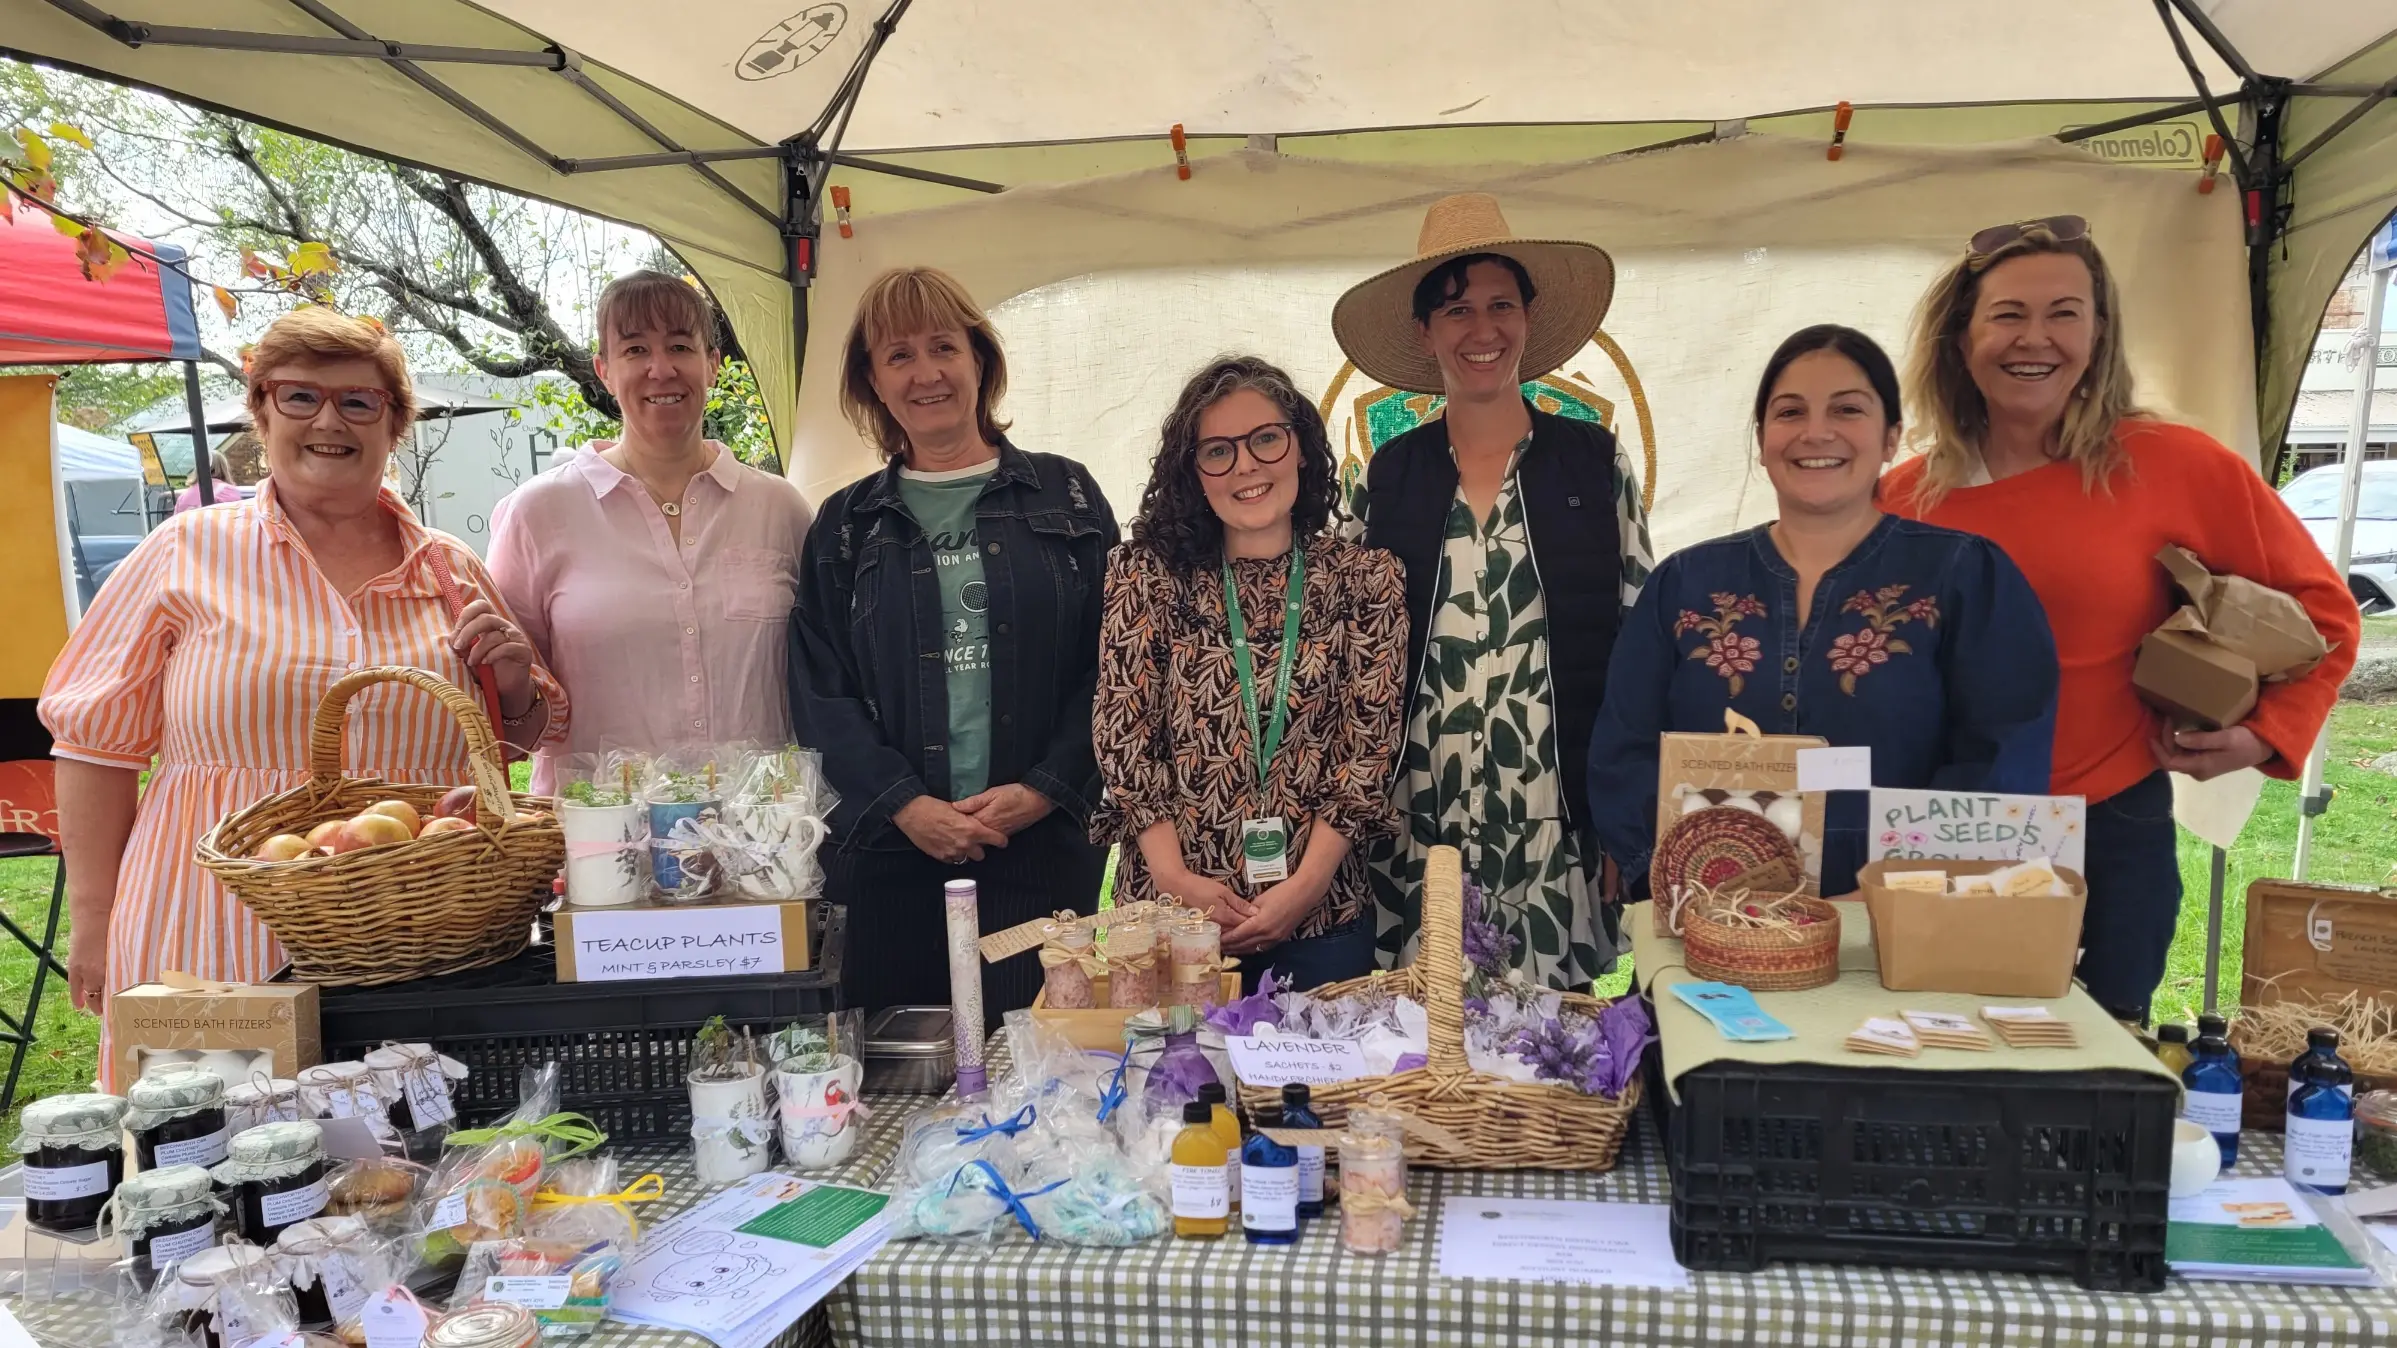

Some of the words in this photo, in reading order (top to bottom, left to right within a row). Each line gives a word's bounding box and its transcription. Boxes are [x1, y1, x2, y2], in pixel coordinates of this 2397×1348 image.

[934, 554, 960, 566] ION
[965, 552, 980, 562] AN
[944, 645, 975, 663] NCE
[954, 663, 977, 672] YEAR
[1681, 759, 1732, 770] SCENTED
[1735, 761, 1764, 772] BATH
[1885, 797, 2001, 828] PLANT
[1934, 822, 2041, 846] SEEDS
[581, 936, 675, 953] TEACUP
[681, 931, 778, 948] PLANTS
[601, 962, 644, 974] MINT
[661, 957, 736, 972] PARSLEY
[740, 956, 763, 970] $7
[133, 1018, 190, 1029] SCENTED
[194, 1019, 225, 1029] BATH
[229, 1019, 272, 1030] FIZZERS
[1243, 1040, 1351, 1055] LAVENDER
[1265, 1061, 1320, 1070] SACHETS
[1328, 1062, 1342, 1072] $2
